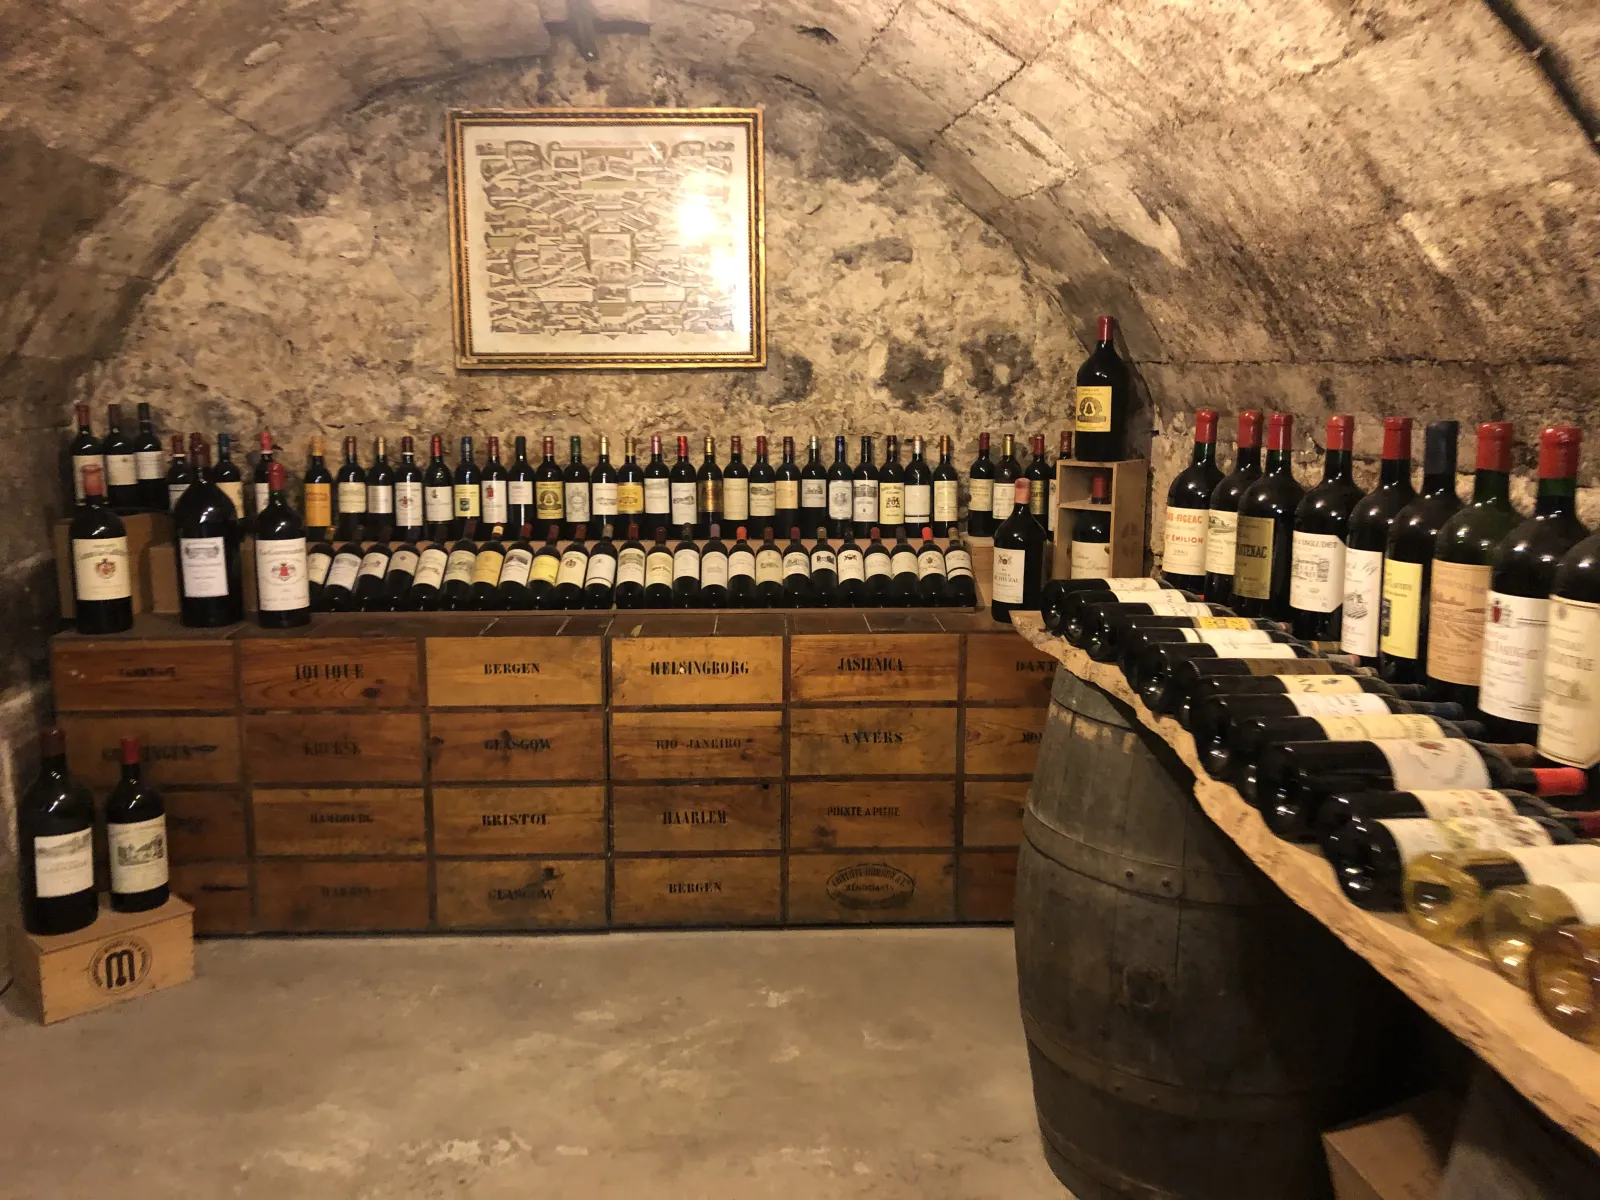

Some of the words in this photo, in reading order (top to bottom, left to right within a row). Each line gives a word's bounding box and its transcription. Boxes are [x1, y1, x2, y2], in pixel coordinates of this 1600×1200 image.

[484, 662, 541, 676] BERGEN
[650, 660, 749, 676] HELSINGBORG
[656, 738, 679, 750] RIO
[840, 730, 904, 745] ANVERS
[481, 813, 549, 827] BRISTOL
[662, 809, 729, 826] HAARLEM
[668, 882, 723, 895] BERGEN
